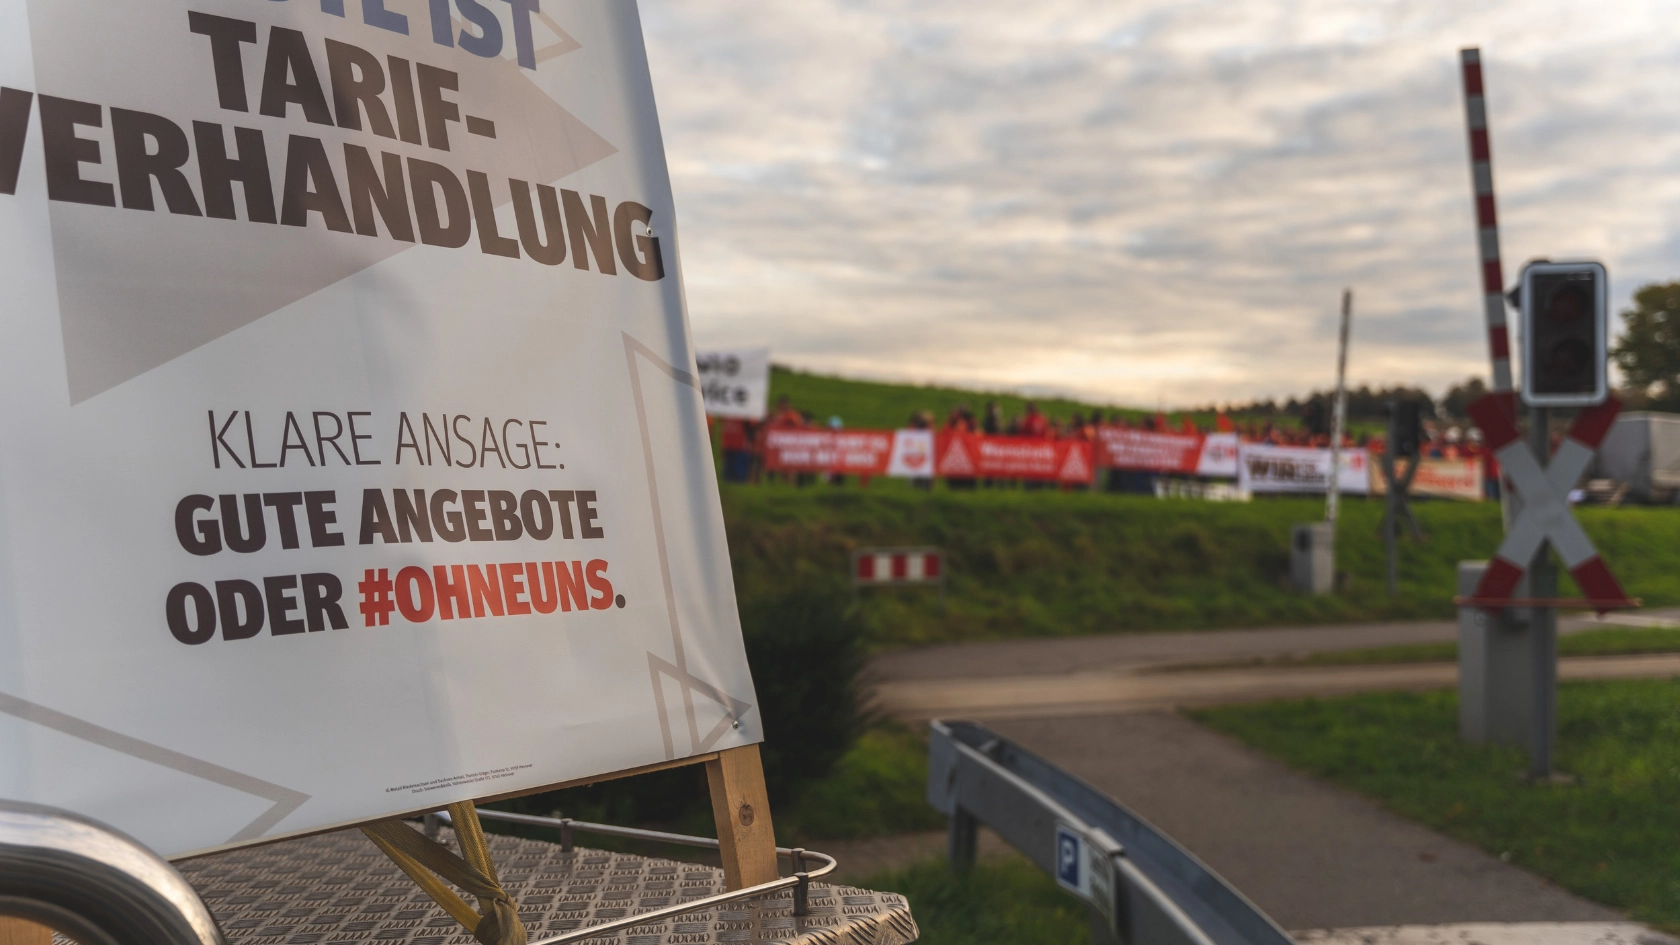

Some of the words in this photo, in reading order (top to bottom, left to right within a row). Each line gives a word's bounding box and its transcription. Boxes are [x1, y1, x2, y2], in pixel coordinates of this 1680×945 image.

[188, 10, 497, 152] TARIF-
[207, 410, 381, 469] KLARE
[395, 411, 565, 470] ANSAGE:
[174, 490, 345, 556] GUTE
[358, 488, 604, 545] ANGEBOTE
[165, 572, 349, 646] ODER
[358, 559, 626, 627] #OHNEUNS.
